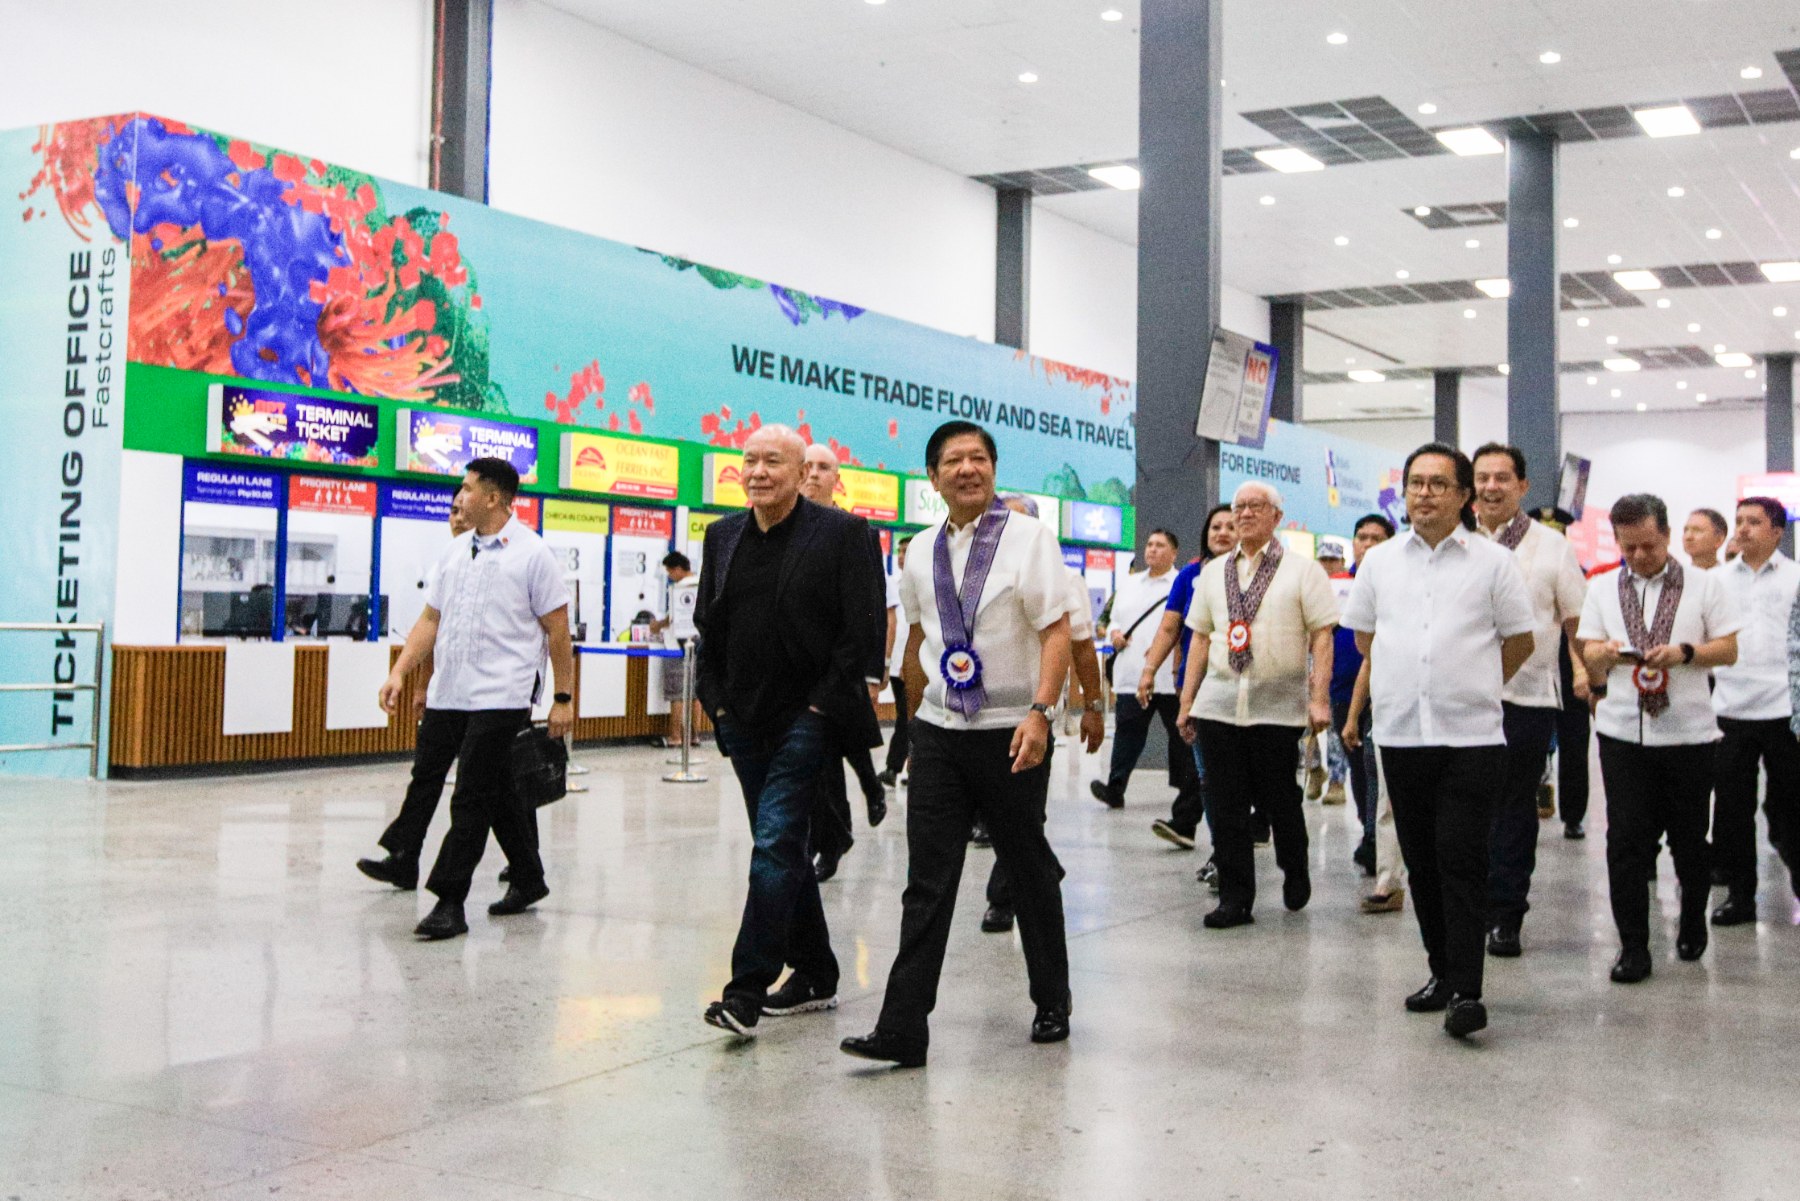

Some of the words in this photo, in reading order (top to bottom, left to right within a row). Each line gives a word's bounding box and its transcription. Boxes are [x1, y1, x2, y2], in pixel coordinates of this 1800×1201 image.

[63, 249, 91, 438] OFFICE
[91, 247, 116, 429] Fastcrafts
[1247, 355, 1268, 385] NO
[731, 344, 775, 379] WE
[780, 354, 856, 396] MAKE
[860, 372, 933, 411] TRADE
[937, 389, 993, 423] FLOW
[996, 402, 1035, 431] AND
[1038, 411, 1072, 439] SEA
[1075, 418, 1133, 451] TRAVEL
[295, 403, 374, 428] TERMINAL
[295, 420, 350, 442] TICKET
[468, 426, 535, 449] TERMINAL
[468, 442, 515, 461] TICKET
[615, 442, 649, 456] OCEAN
[615, 460, 648, 476] FERRIES
[1221, 451, 1244, 474] FOR
[1246, 457, 1301, 484] EVERYONE
[196, 472, 244, 485] REGULAR
[245, 476, 273, 488] LANE
[300, 476, 341, 490] PRIORITY
[342, 481, 368, 493] LANE
[391, 490, 431, 502] REGULAR
[577, 514, 607, 524] COUNTER
[619, 507, 648, 518] PRIORITY
[568, 547, 580, 572] 3
[636, 551, 647, 575] 3
[52, 450, 83, 736] TICKETING
